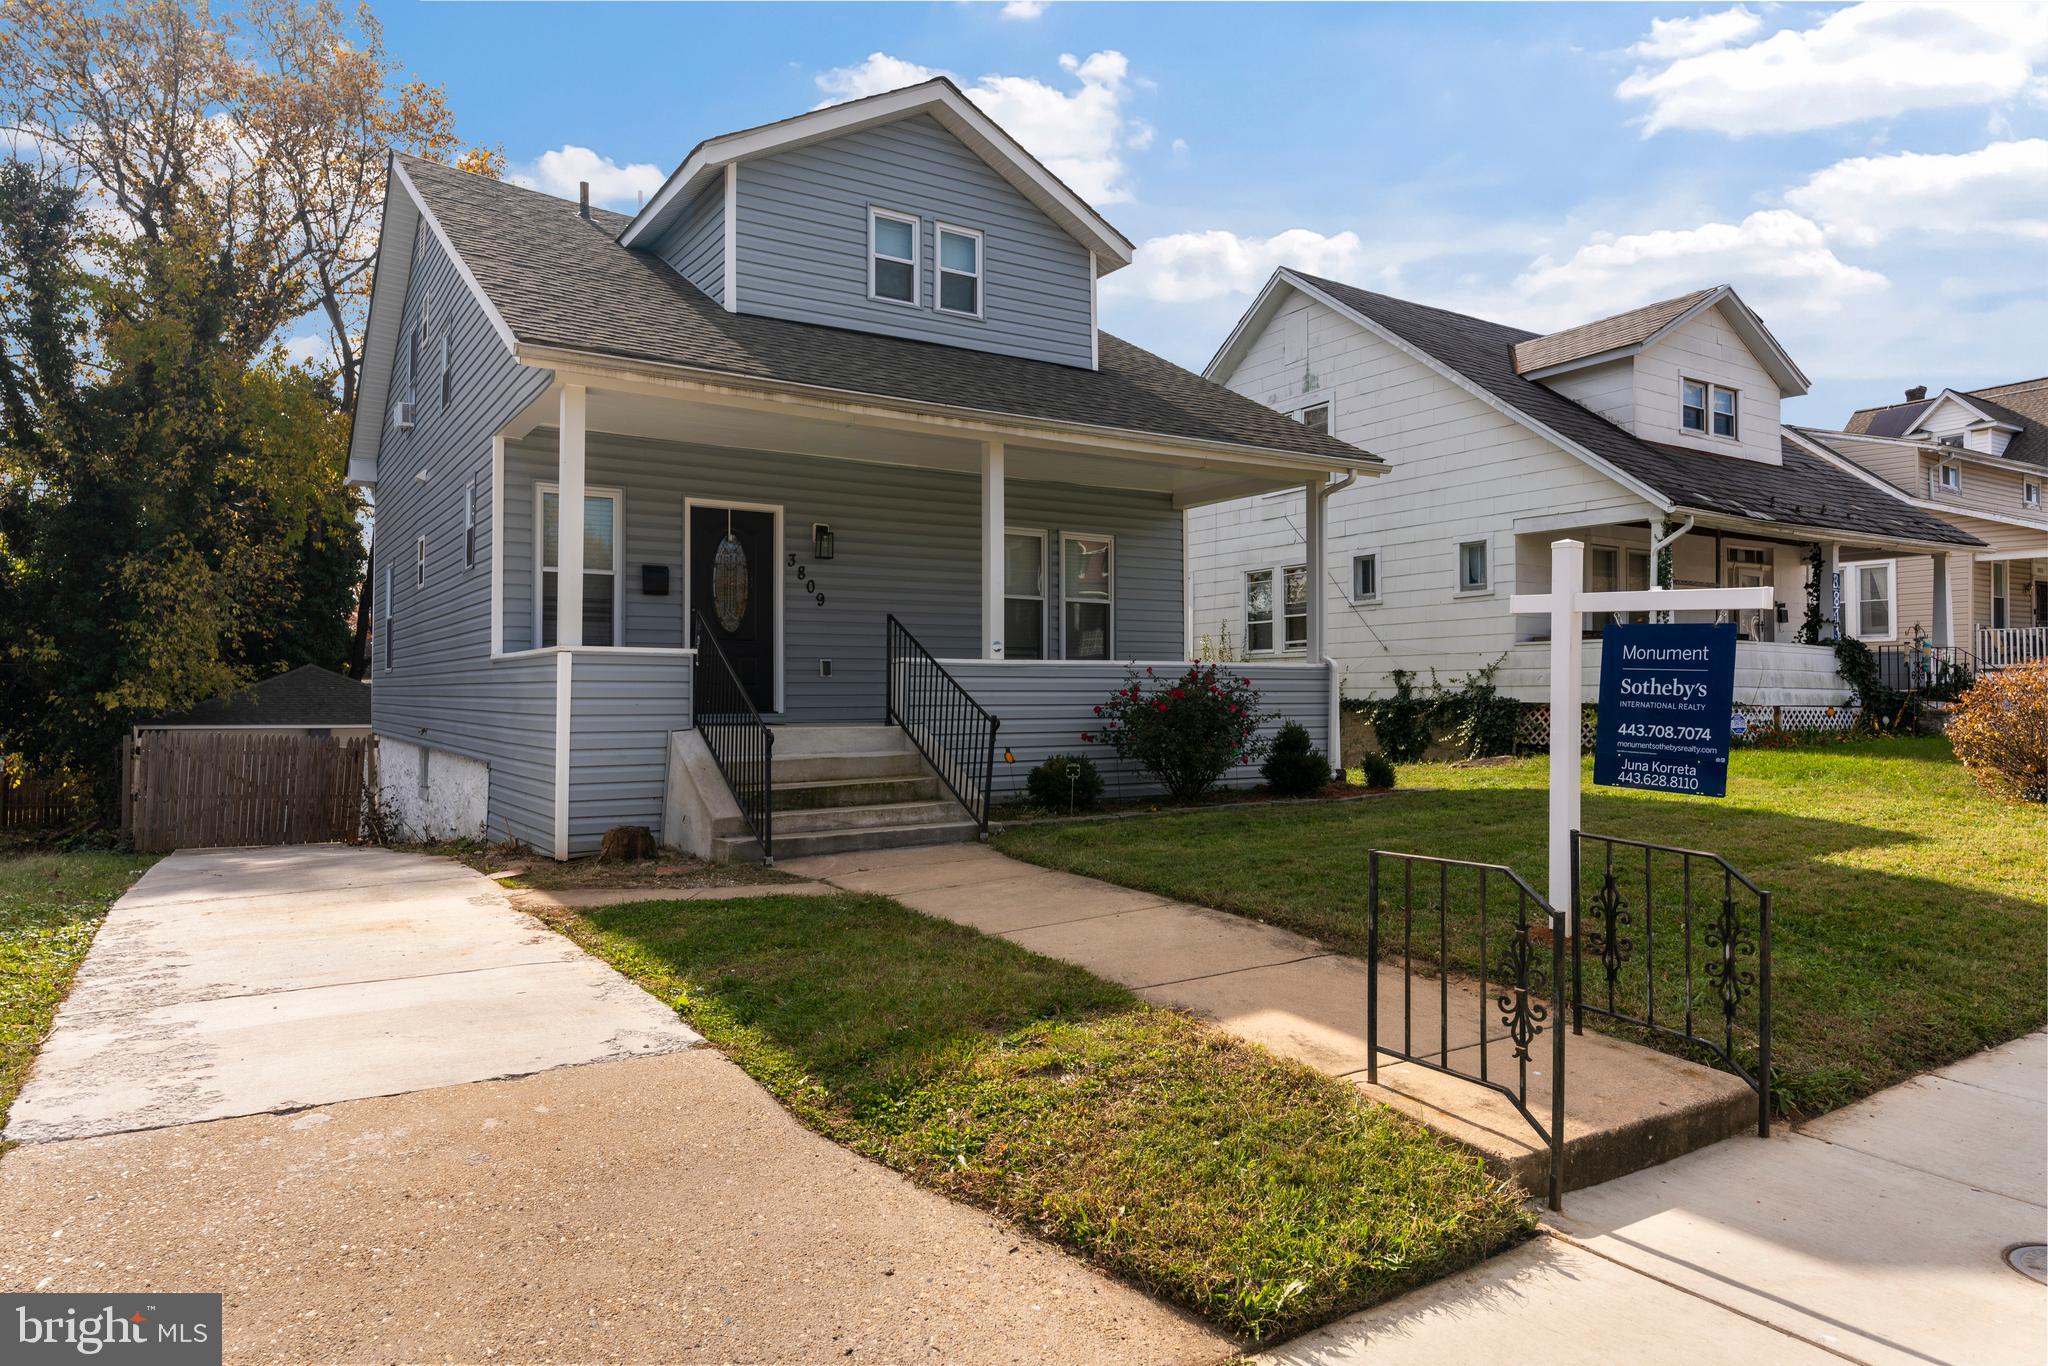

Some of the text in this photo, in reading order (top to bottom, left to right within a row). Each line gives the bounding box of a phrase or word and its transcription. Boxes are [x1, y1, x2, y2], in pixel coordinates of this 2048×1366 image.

[787, 553, 825, 607] 3809
[1622, 644, 1710, 661] Monument
[1620, 677, 1708, 701] Sotheby's
[1619, 700, 1706, 711] INTERNATIONAL REALTY
[1617, 723, 1712, 741] 443.708.7074
[1616, 741, 1718, 755] monumentsothebysrealty.com
[1621, 759, 1697, 776] Juna Korreta
[1617, 771, 1699, 790] 443.628.8110
